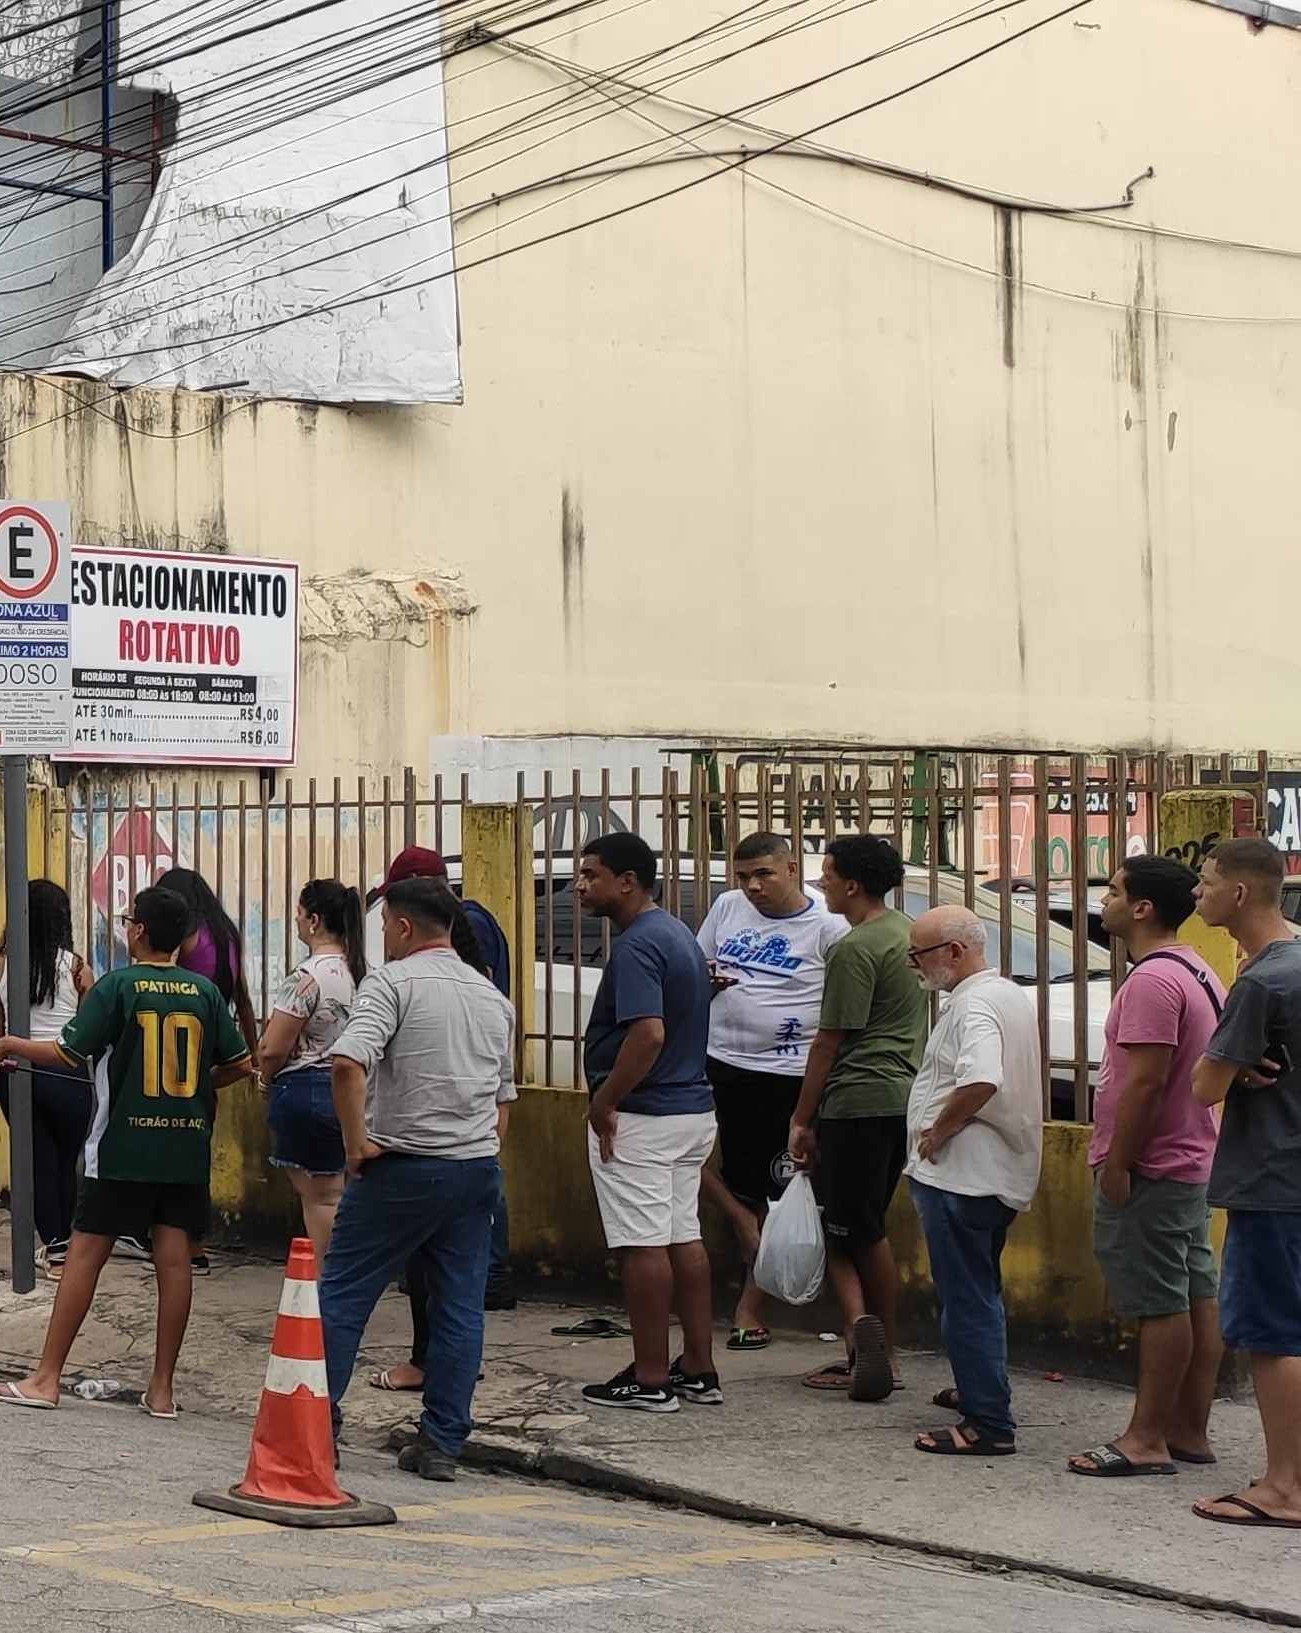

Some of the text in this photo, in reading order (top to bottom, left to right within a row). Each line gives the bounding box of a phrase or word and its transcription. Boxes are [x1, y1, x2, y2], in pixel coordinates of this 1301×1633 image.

[9, 527, 34, 578] E
[72, 560, 287, 618] ESTACIONAMENTO
[24, 605, 59, 617] AZUL
[119, 619, 240, 666] ROTATIVO
[21, 645, 29, 656] 2
[30, 645, 67, 657] HORAS
[81, 671, 116, 682] HORÁRIO
[117, 673, 127, 683] DE
[73, 687, 135, 699] FUNCIONAMENTO
[75, 703, 97, 718] ATÉ
[75, 726, 97, 742] ATÉ
[100, 730, 105, 742] 1
[134, 980, 199, 996] IPATINGA
[136, 1010, 204, 1098] 10
[172, 1118, 186, 1128] DE
